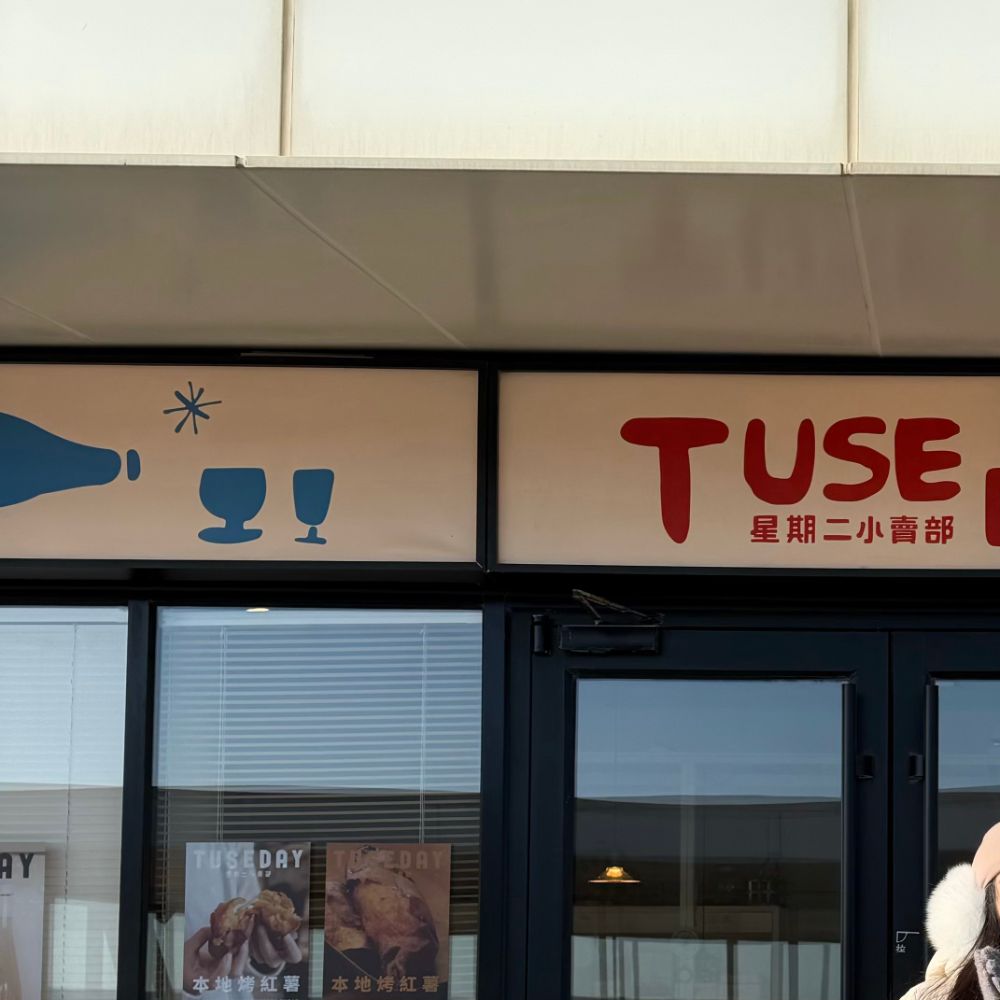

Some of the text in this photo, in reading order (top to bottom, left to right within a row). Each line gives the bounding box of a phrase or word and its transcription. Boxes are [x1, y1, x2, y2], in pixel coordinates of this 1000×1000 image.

[750, 514, 955, 545] 星期二小賣部
[0, 852, 34, 879] AY
[193, 849, 304, 869] TUSEDAY
[333, 850, 446, 869] TUEDAY
[192, 975, 300, 993] 本地烤紅薯
[331, 975, 440, 993] 本地烤紅薯
